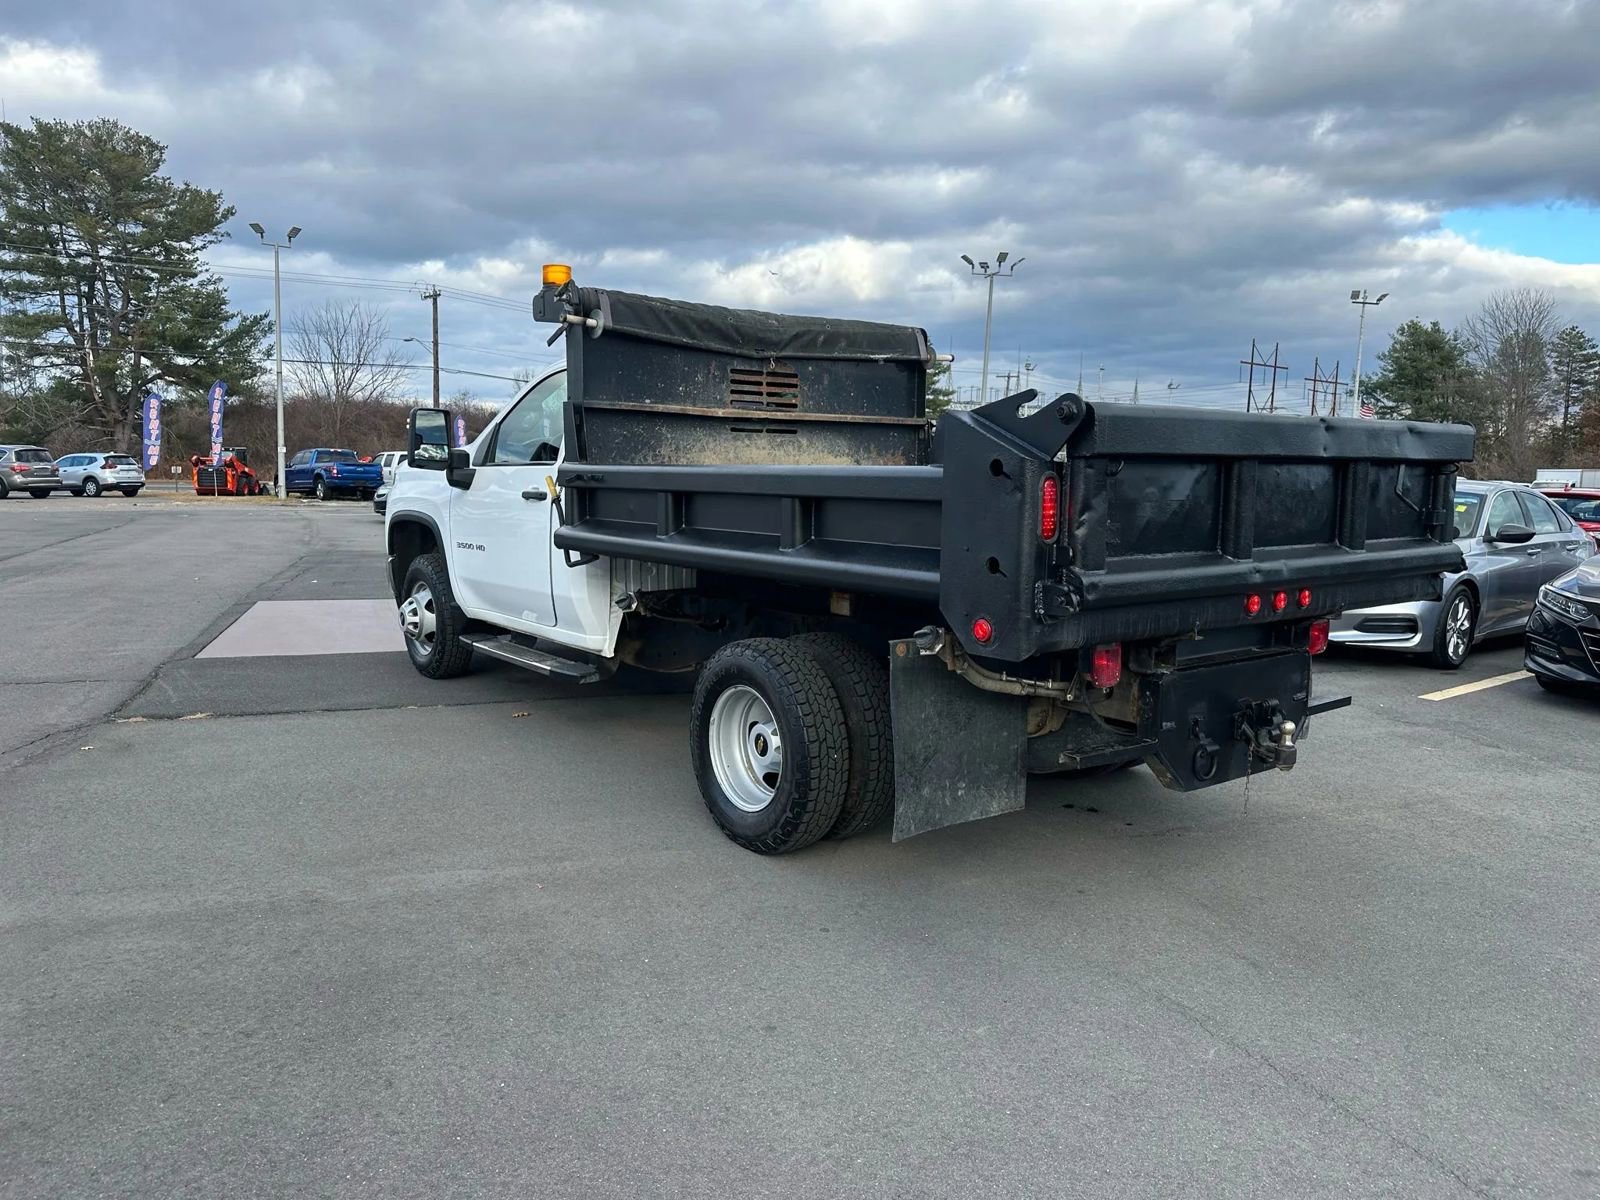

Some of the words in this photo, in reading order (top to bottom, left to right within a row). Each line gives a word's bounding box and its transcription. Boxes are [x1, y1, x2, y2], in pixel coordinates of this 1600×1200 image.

[148, 398, 160, 441] RENT
[211, 387, 223, 438] RENT
[457, 419, 466, 447] REN
[147, 445, 160, 466] ME
[456, 541, 475, 550] 3500
